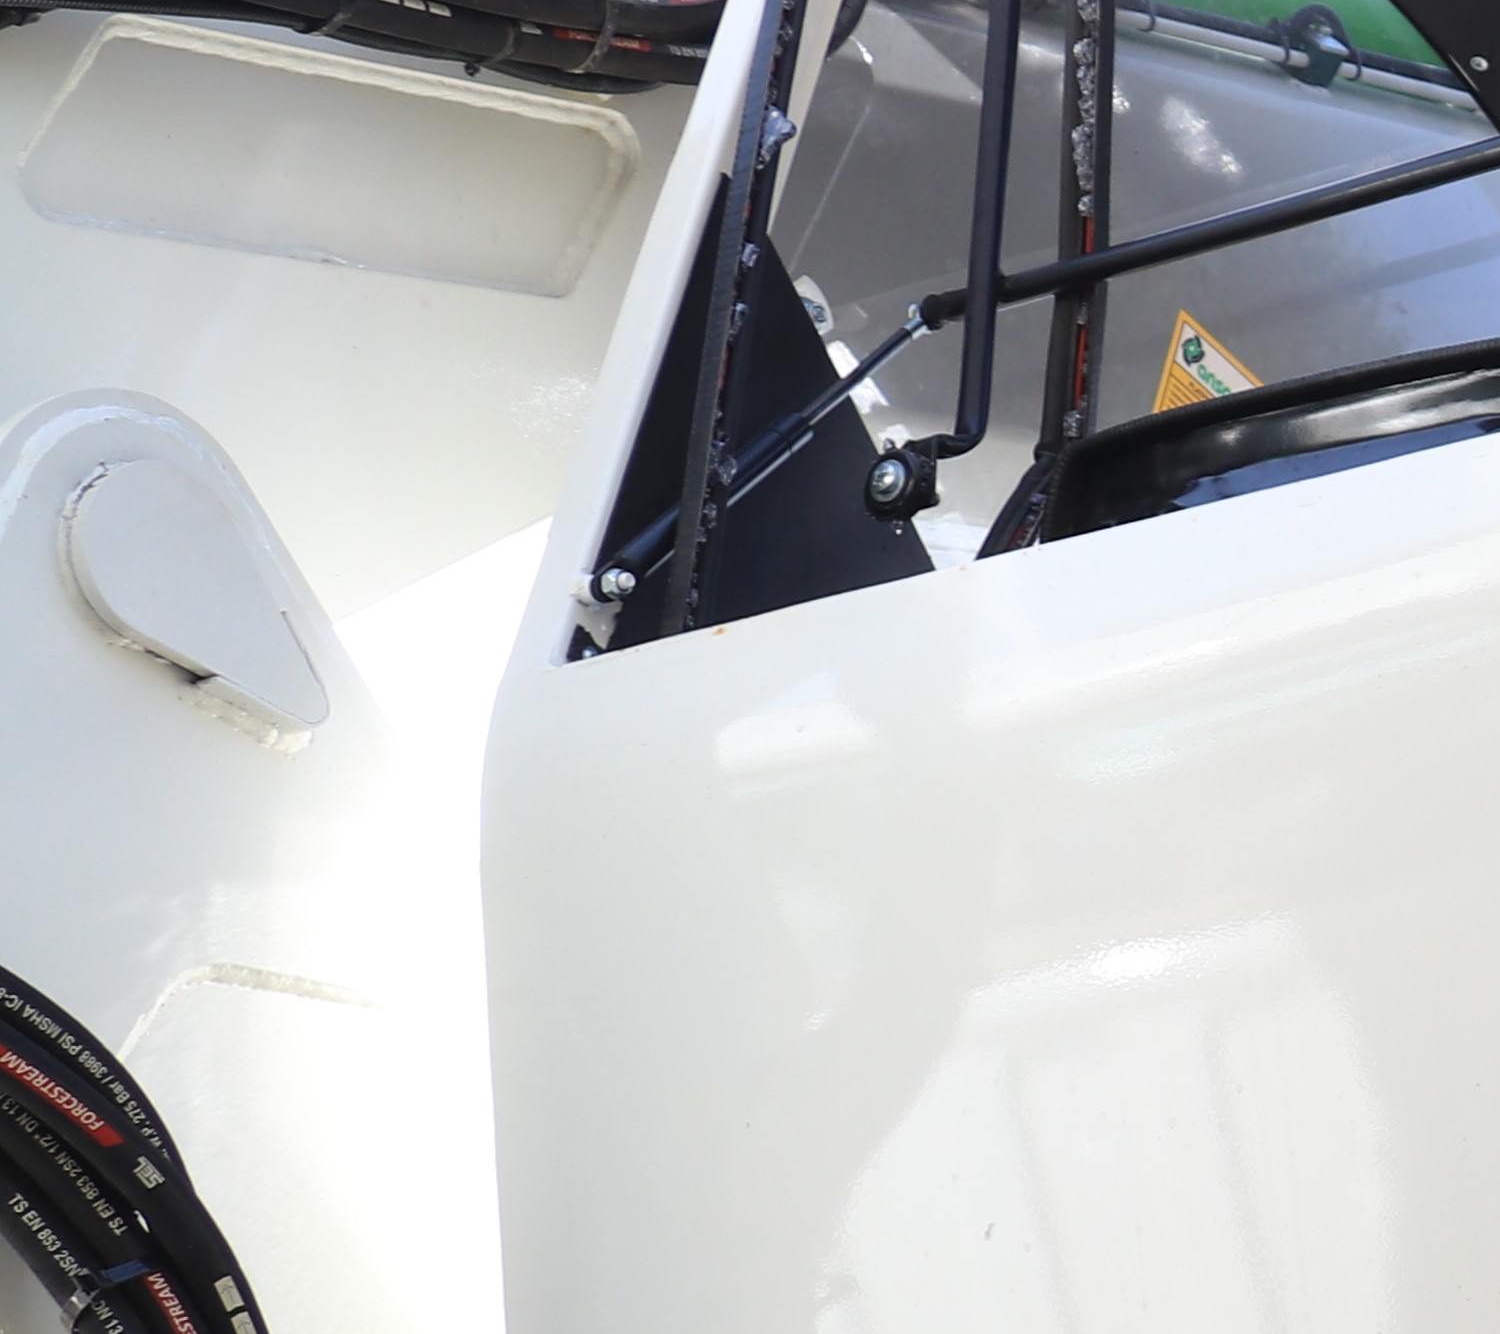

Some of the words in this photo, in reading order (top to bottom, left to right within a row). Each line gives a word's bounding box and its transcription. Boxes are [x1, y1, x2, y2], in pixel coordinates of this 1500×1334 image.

[22, 1003, 62, 1039] MSHA
[58, 1032, 83, 1056] PSI
[78, 1050, 108, 1079] 3988
[0, 1050, 105, 1131] FORCESTREAM
[108, 1078, 130, 1102] Bar
[15, 1113, 39, 1133] DN
[123, 1099, 145, 1125] 275
[54, 1151, 83, 1178] 2SN
[75, 1175, 100, 1200] 853
[92, 1198, 116, 1218] EN
[8, 1192, 29, 1214] TS
[21, 1210, 46, 1232] EN
[37, 1227, 61, 1252] 853
[53, 1249, 82, 1277] 2SN
[108, 1217, 128, 1236] TS
